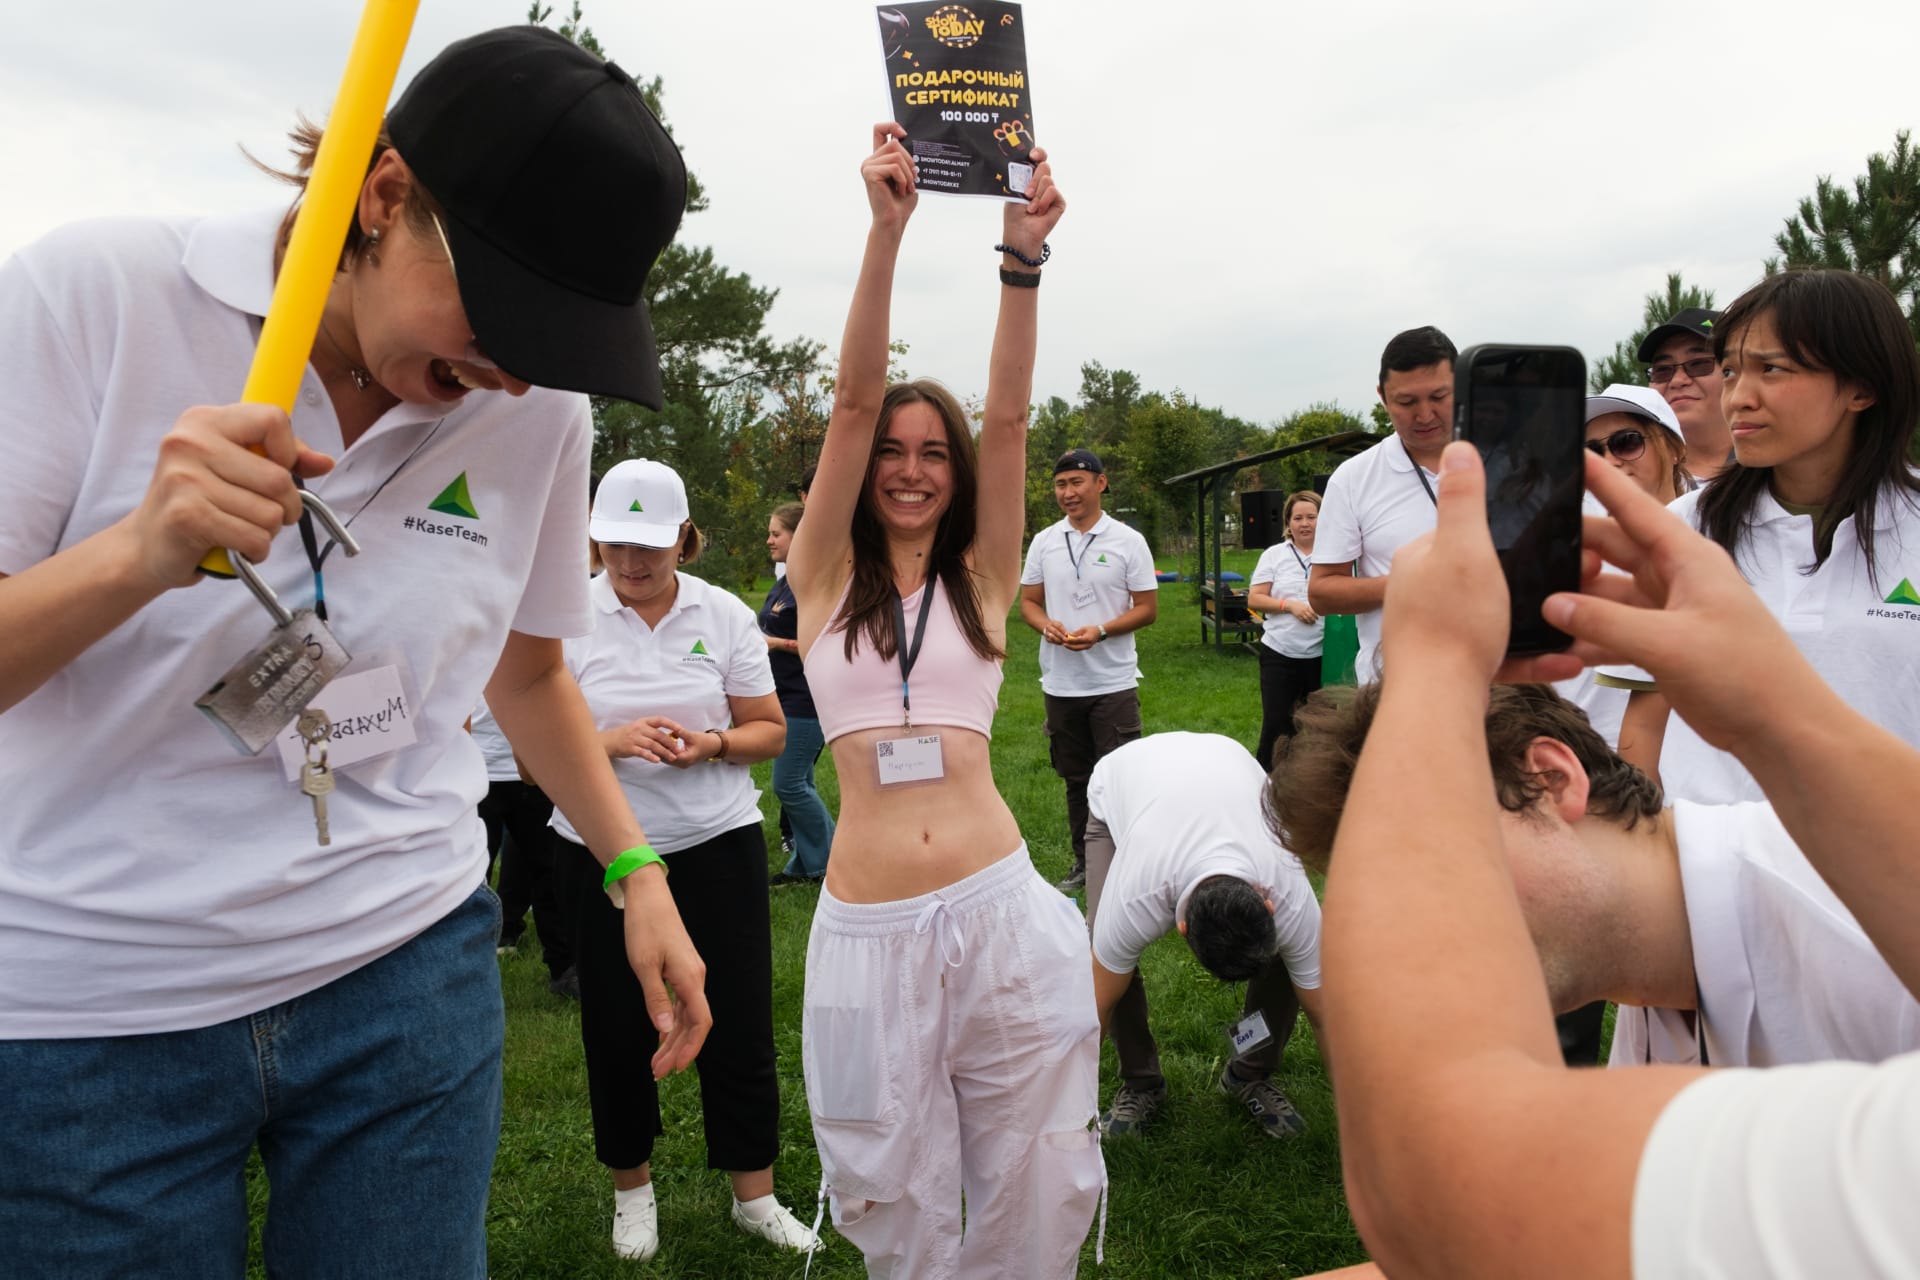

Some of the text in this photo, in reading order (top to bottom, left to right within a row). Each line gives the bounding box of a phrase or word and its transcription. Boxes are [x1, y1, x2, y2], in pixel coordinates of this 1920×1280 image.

[925, 13, 958, 26] SHOW
[927, 19, 985, 39] TODAY
[895, 70, 1024, 89] ПОДАРОЧНЫЙ
[905, 88, 1019, 108] СЕРТИФИКАТ
[940, 110, 962, 121] 100
[965, 112, 989, 123] 000
[403, 515, 489, 547] #KaseTeam
[248, 646, 293, 688] EXTRA
